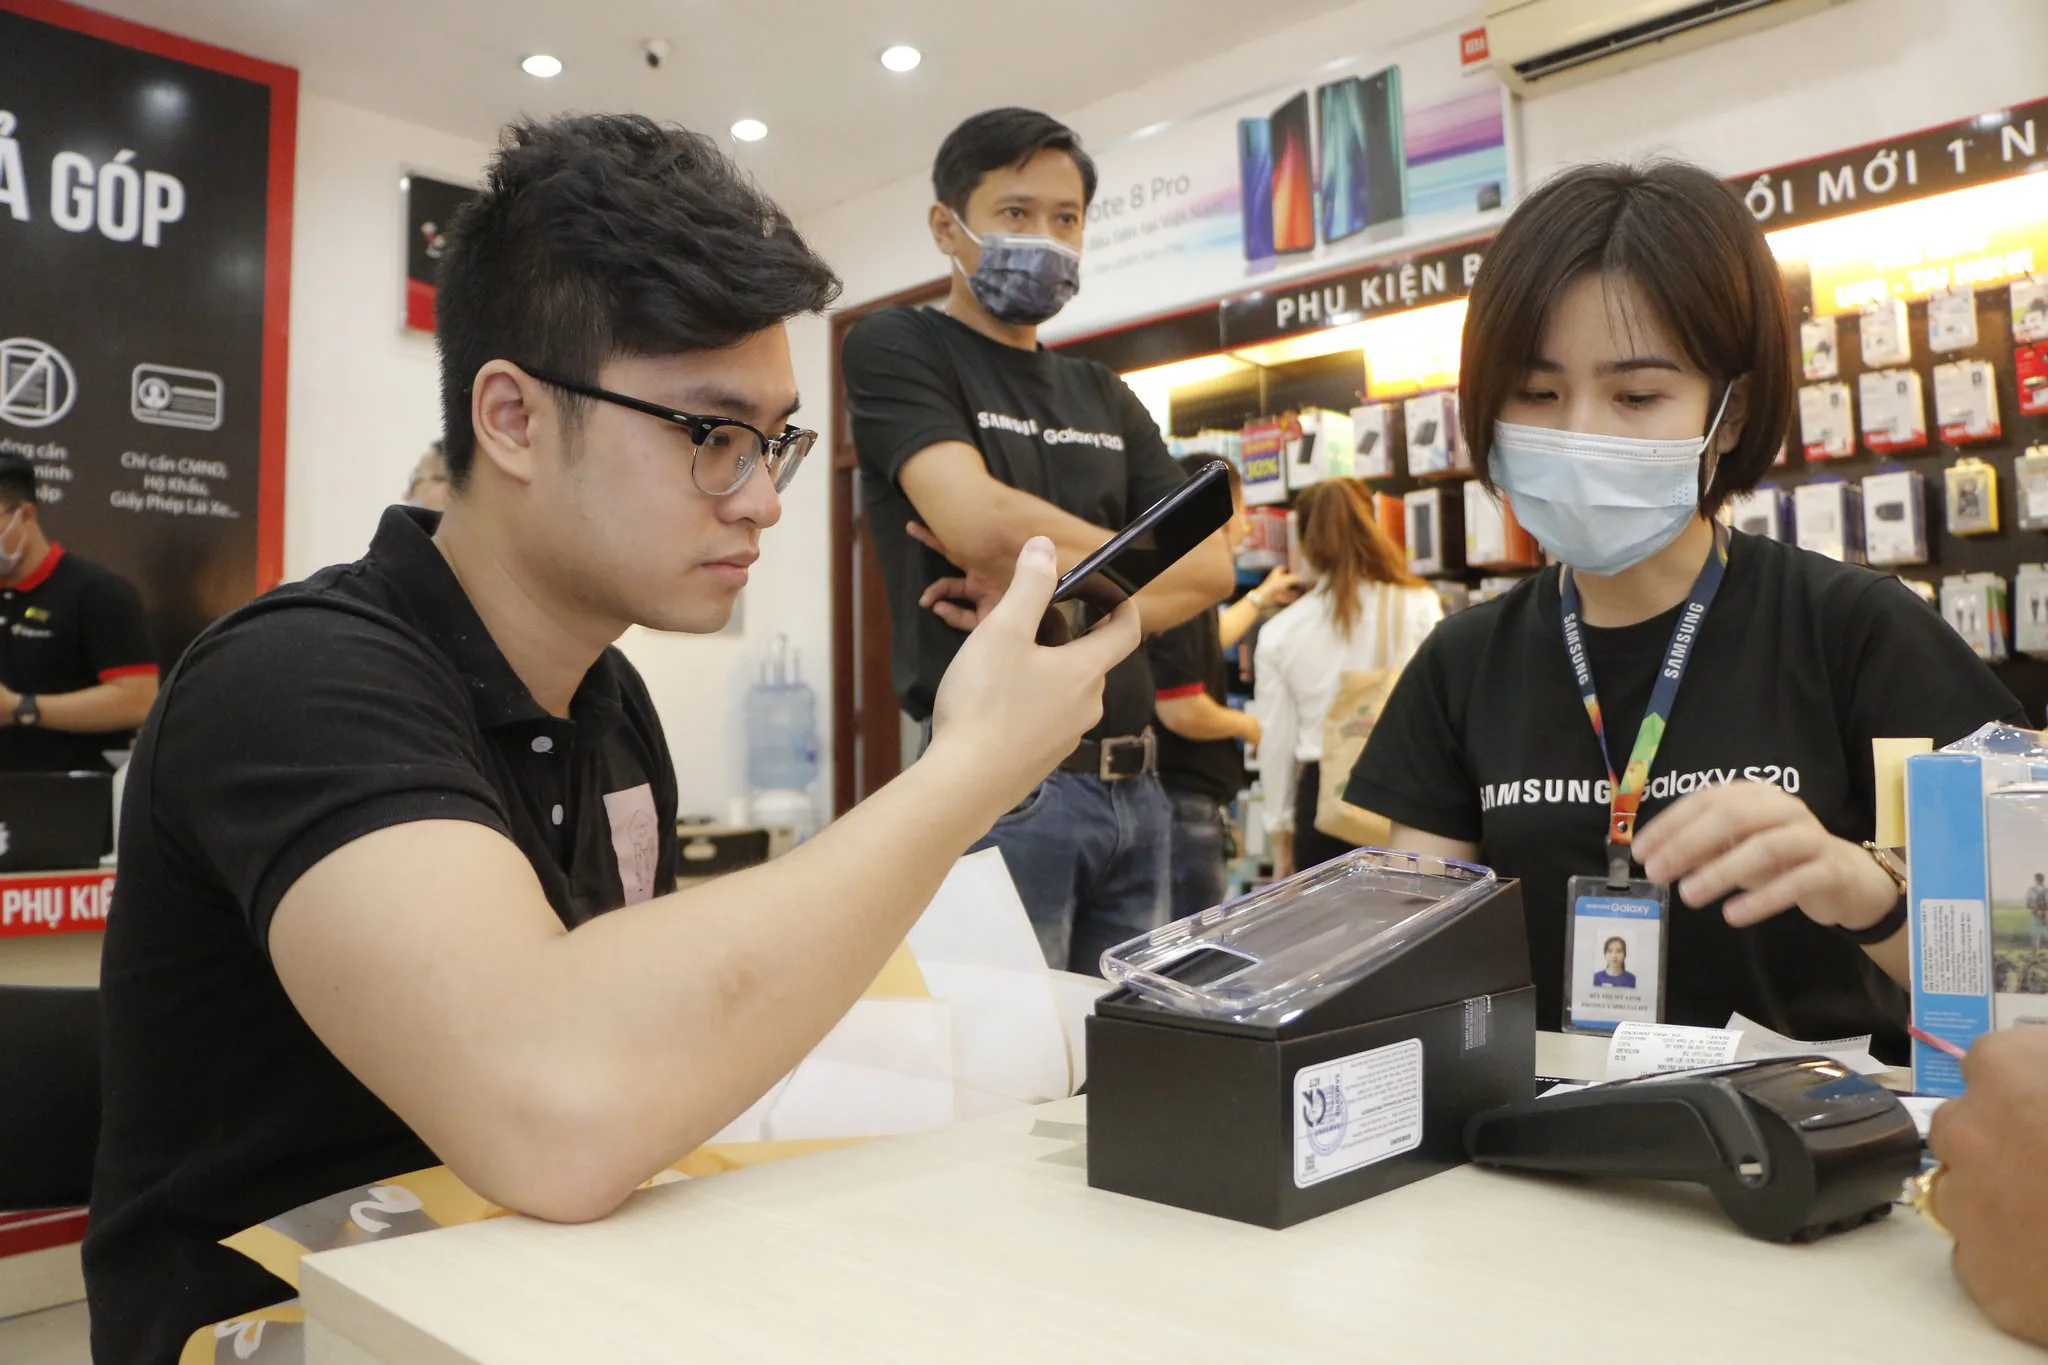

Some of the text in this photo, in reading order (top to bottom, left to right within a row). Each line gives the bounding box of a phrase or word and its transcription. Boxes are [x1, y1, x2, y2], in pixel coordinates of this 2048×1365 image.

[1744, 118, 2048, 221] ỔI MỚI 1 N
[50, 150, 185, 248] GÓP
[1087, 174, 1190, 224] ote 8 Pro
[1361, 261, 1447, 308] KIỆN
[1563, 612, 1589, 686] SAMSUNG
[1664, 602, 1704, 680] SAMSUNG
[1640, 769, 1737, 802] alaxy
[3, 886, 64, 930] PHỤ
[1611, 902, 1650, 915] Galaxy
